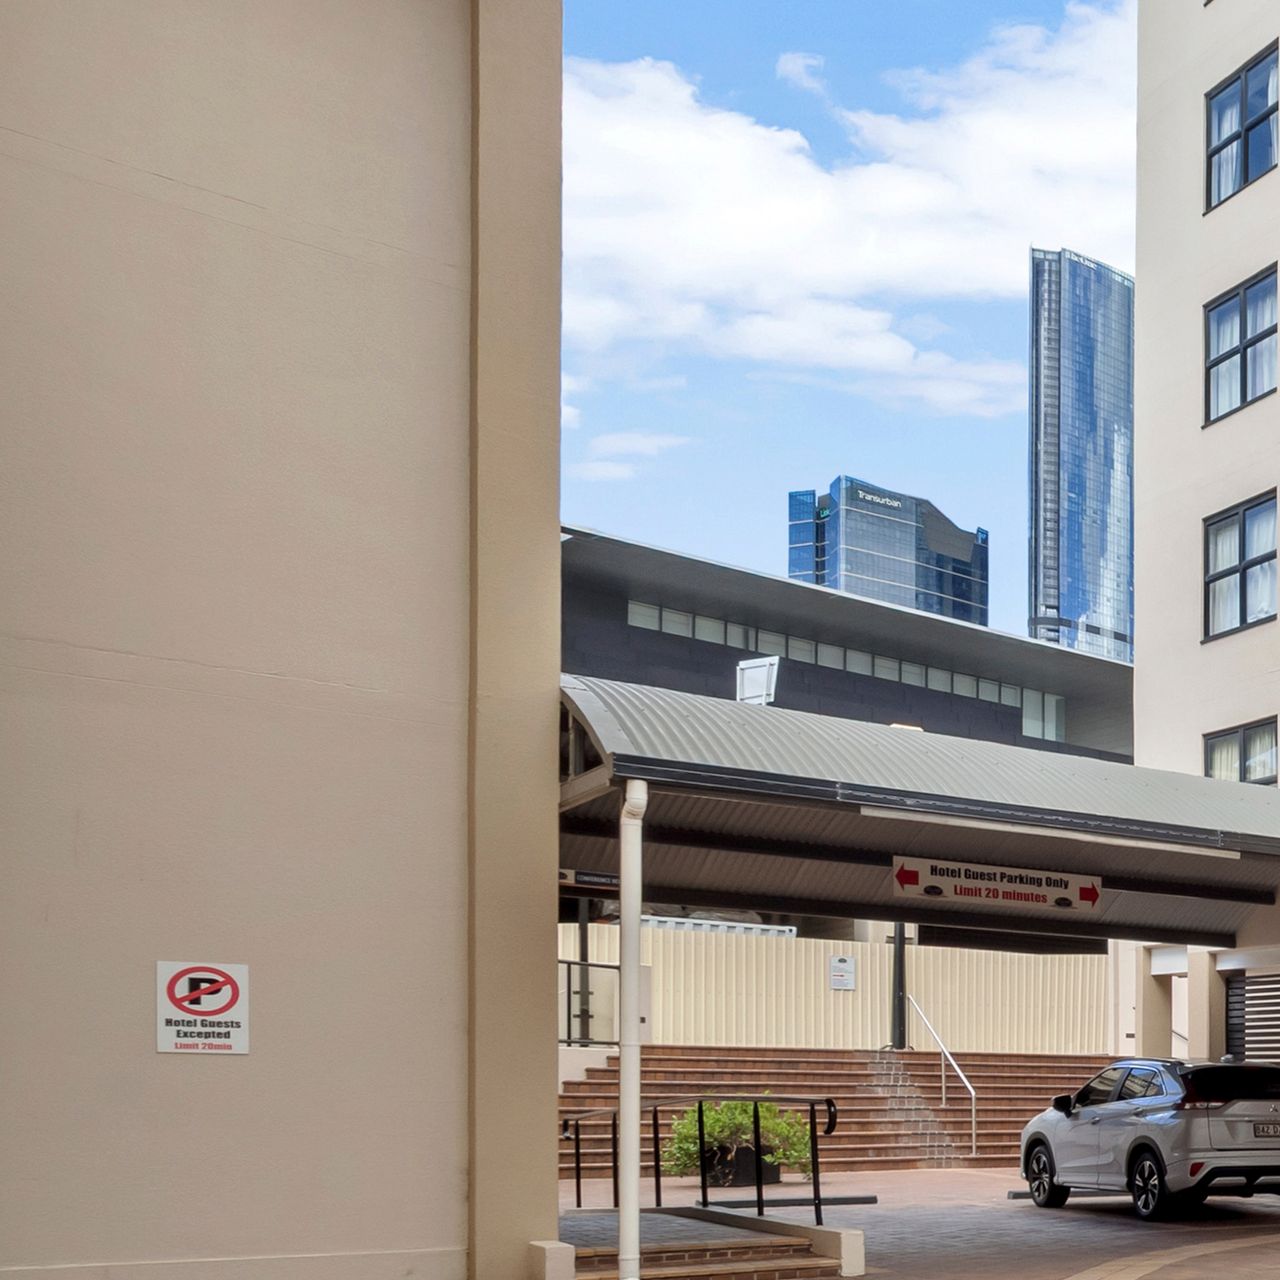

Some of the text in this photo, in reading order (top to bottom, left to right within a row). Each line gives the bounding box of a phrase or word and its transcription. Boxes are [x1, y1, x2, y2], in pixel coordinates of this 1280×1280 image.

[858, 490, 902, 508] Transurban
[930, 865, 1070, 890] Hotel Guest Parking Only
[954, 885, 1048, 904] Limit 20 minutes
[165, 1018, 241, 1029] Hotel Guests
[176, 1029, 231, 1039] Excepted
[175, 1042, 199, 1050] Limit
